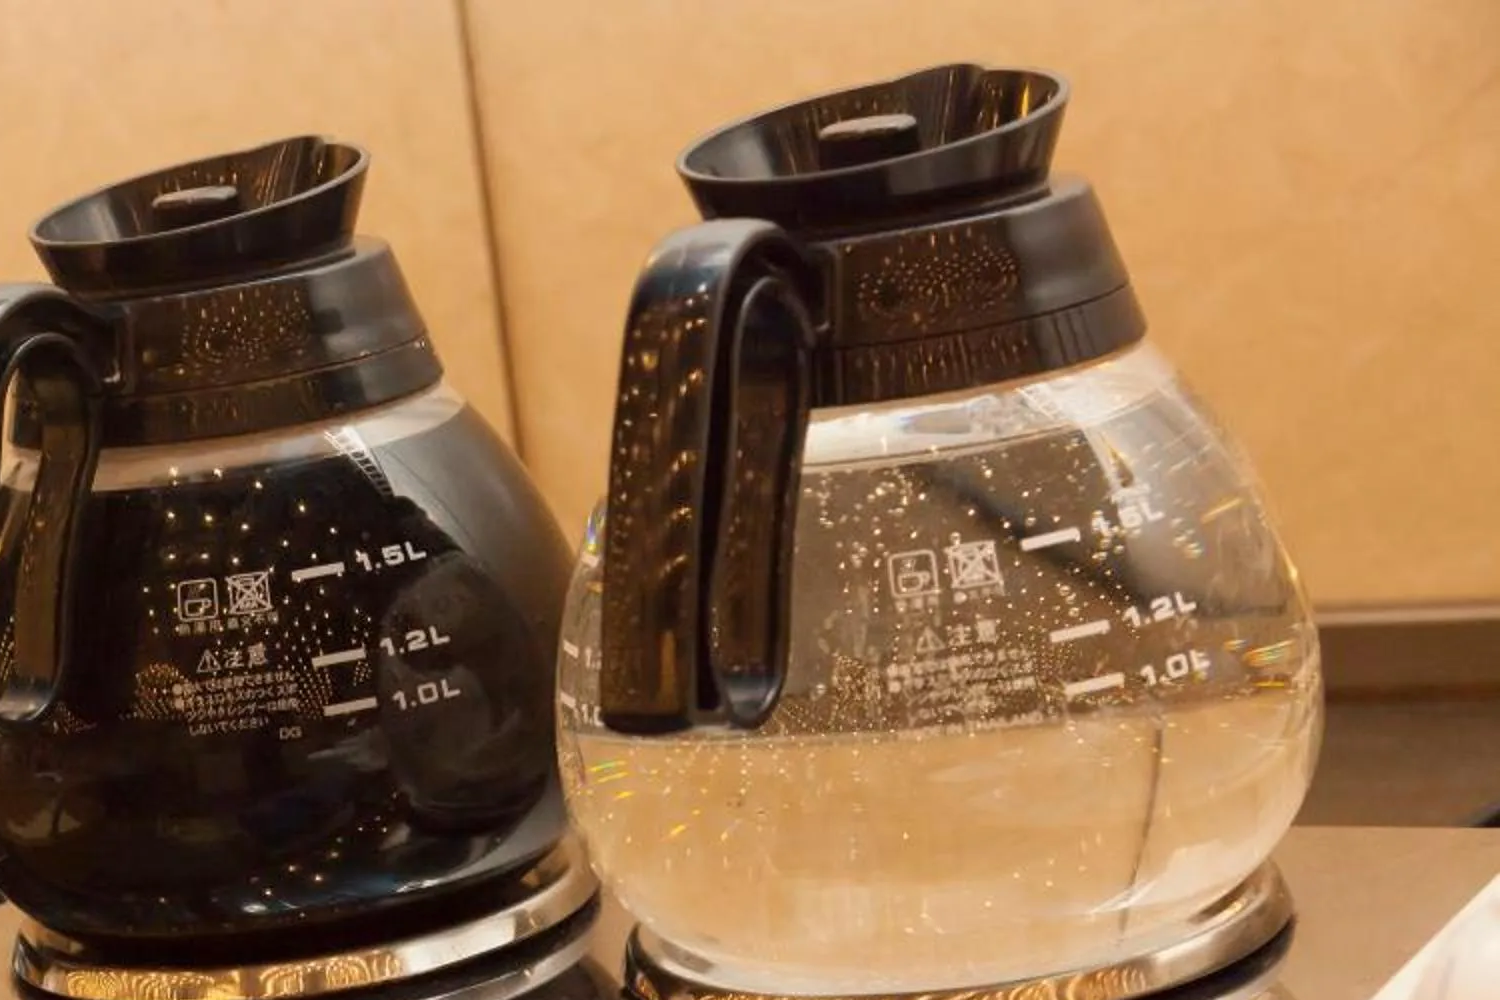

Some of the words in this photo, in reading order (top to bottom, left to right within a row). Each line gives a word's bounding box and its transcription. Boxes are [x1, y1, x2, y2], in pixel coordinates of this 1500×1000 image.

[355, 541, 427, 571] 1.5L
[1122, 591, 1197, 627] 1.2L
[379, 625, 451, 657] 1.2L
[392, 678, 462, 710] 1.0L
